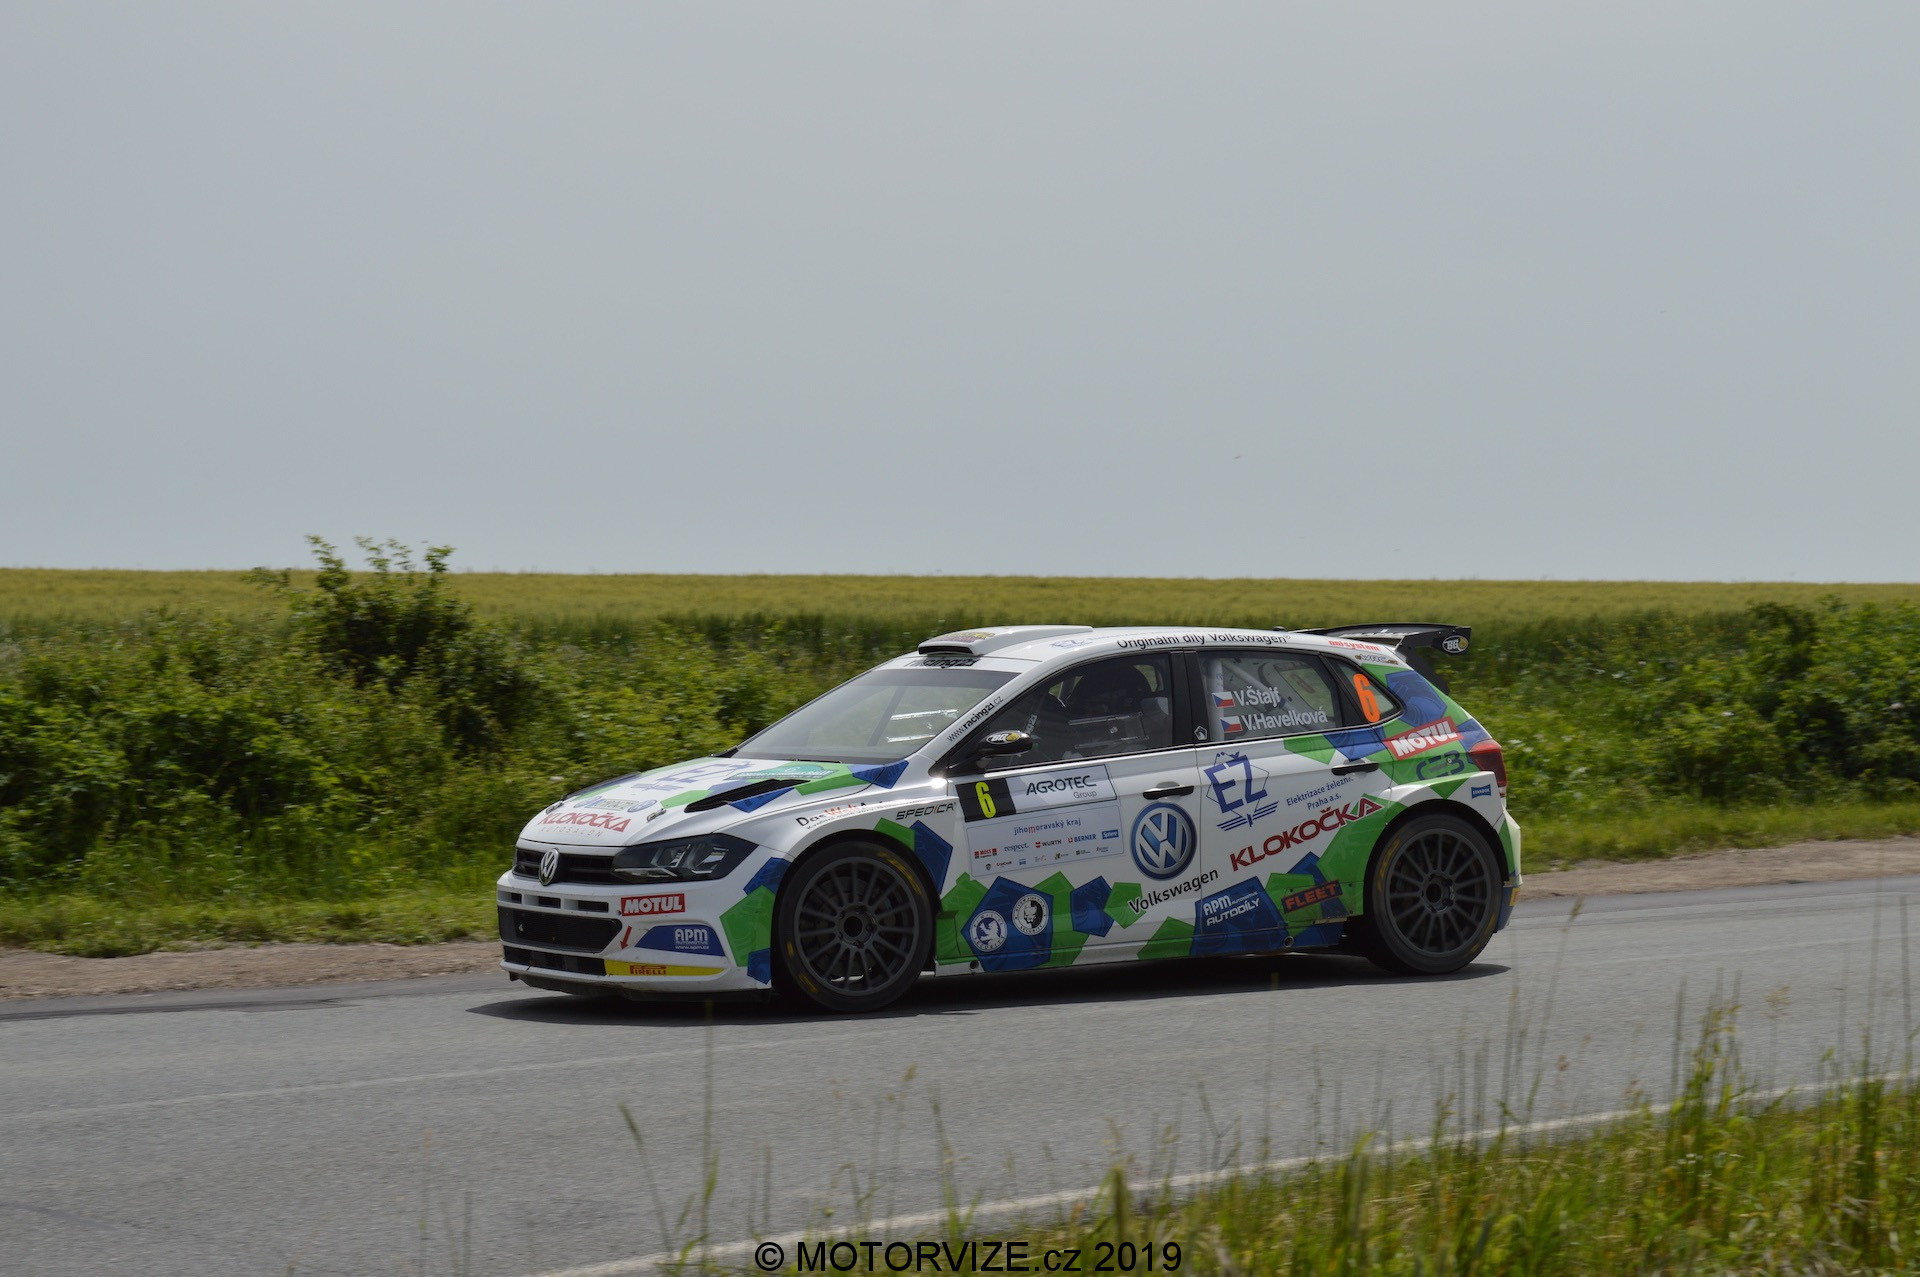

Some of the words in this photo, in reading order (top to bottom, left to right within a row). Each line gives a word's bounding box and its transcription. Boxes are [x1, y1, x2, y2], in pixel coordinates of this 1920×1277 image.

[1234, 685, 1281, 708] V.Štajf
[1353, 673, 1382, 723] 6
[1241, 706, 1328, 731] V.Havelková
[1391, 721, 1458, 757] MOTUL
[1026, 775, 1097, 796] AGROTEC
[1073, 789, 1098, 799] Group
[975, 781, 997, 819] 6
[1286, 787, 1326, 807] Elektrizace
[1306, 798, 1329, 811] Praha
[1329, 793, 1342, 802] a.s.
[538, 812, 632, 833] KLOKOČKA
[1013, 820, 1064, 836] jihomoravský
[1066, 817, 1082, 828] kraj
[1074, 833, 1097, 843] BERNER
[1229, 797, 1385, 872] KLOKOČKA
[1128, 868, 1219, 914] Volkswagen
[1286, 883, 1338, 910] FLEET
[624, 896, 683, 914] MOTUL
[1203, 895, 1232, 916] APM
[1206, 898, 1260, 927] AUTODÍLY
[674, 928, 709, 941] APM
[629, 965, 667, 975] PIRELLI
